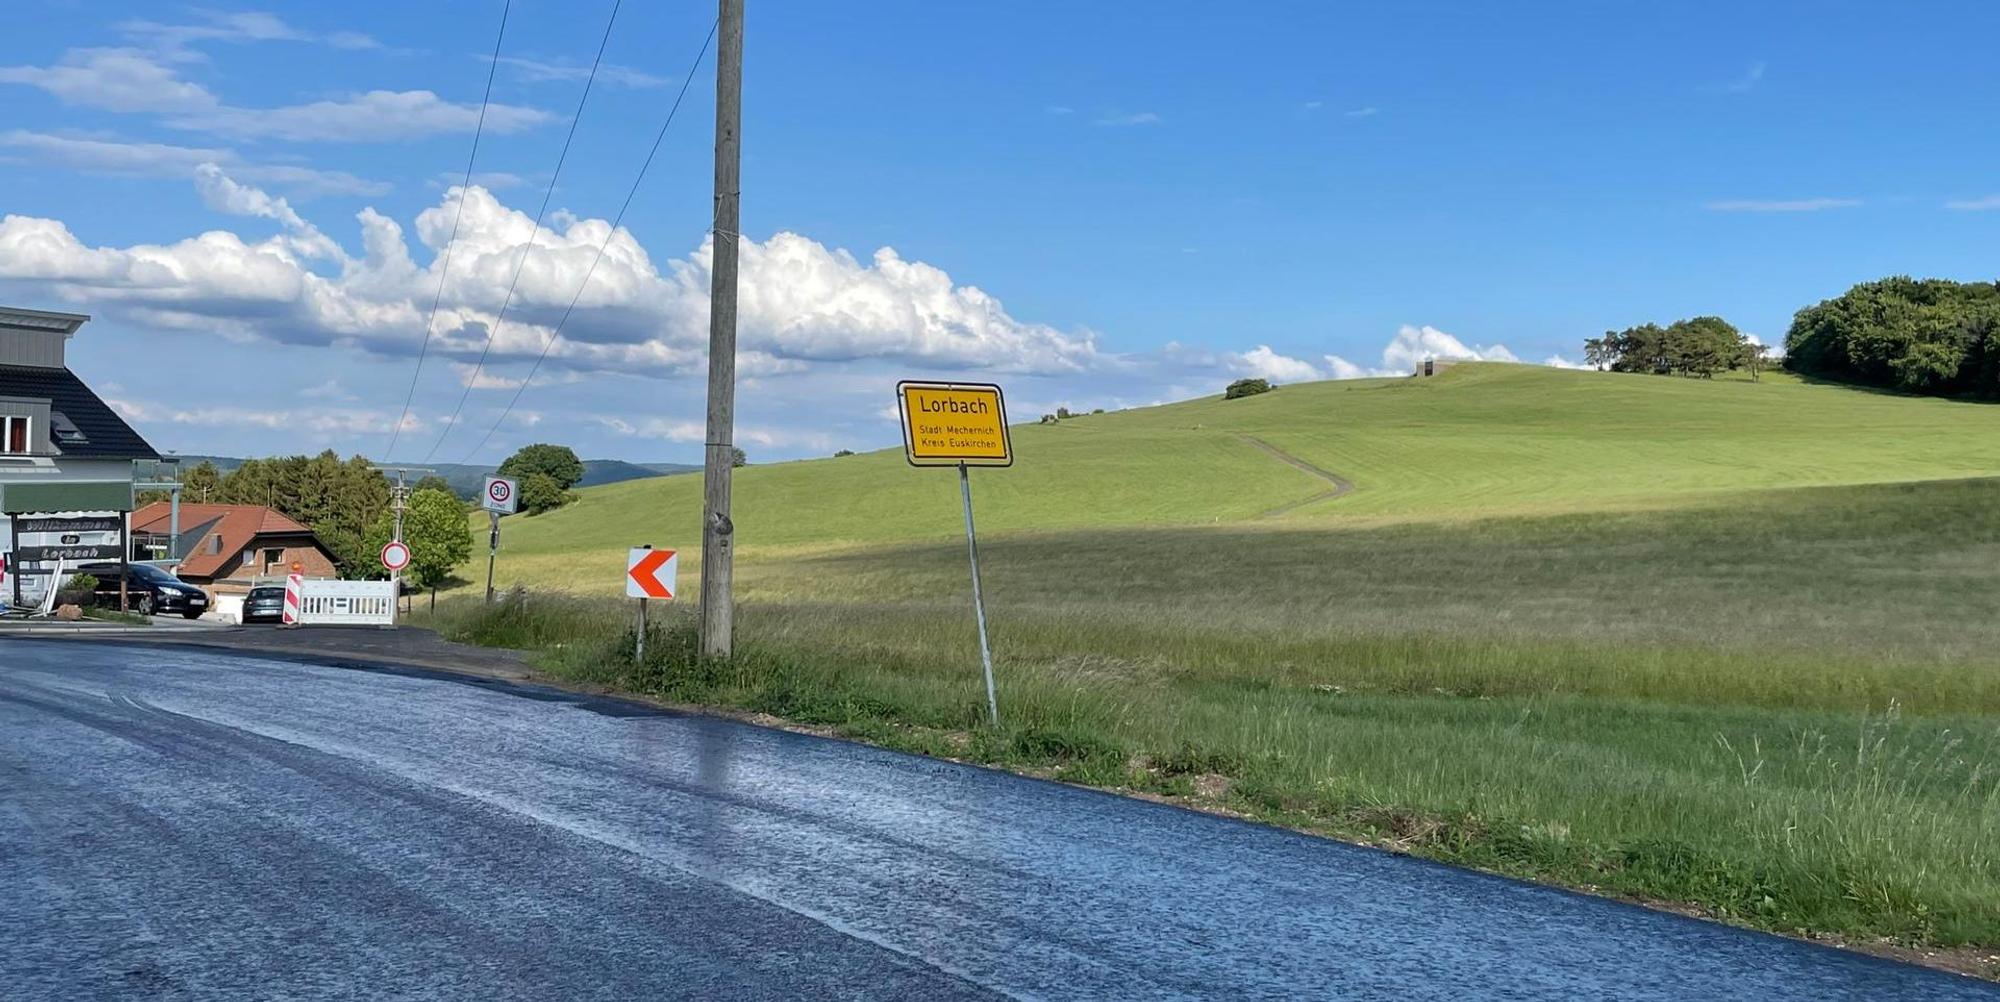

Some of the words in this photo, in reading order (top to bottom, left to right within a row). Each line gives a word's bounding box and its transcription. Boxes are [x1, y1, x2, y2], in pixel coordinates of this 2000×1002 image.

[920, 396, 988, 414] Lorbach
[920, 425, 942, 434] Stadt
[947, 426, 994, 435] Mechernich
[922, 438, 945, 448] Kreis
[950, 439, 996, 449] Euskirchen
[493, 485, 506, 497] 30
[41, 548, 98, 558] Lorbach
